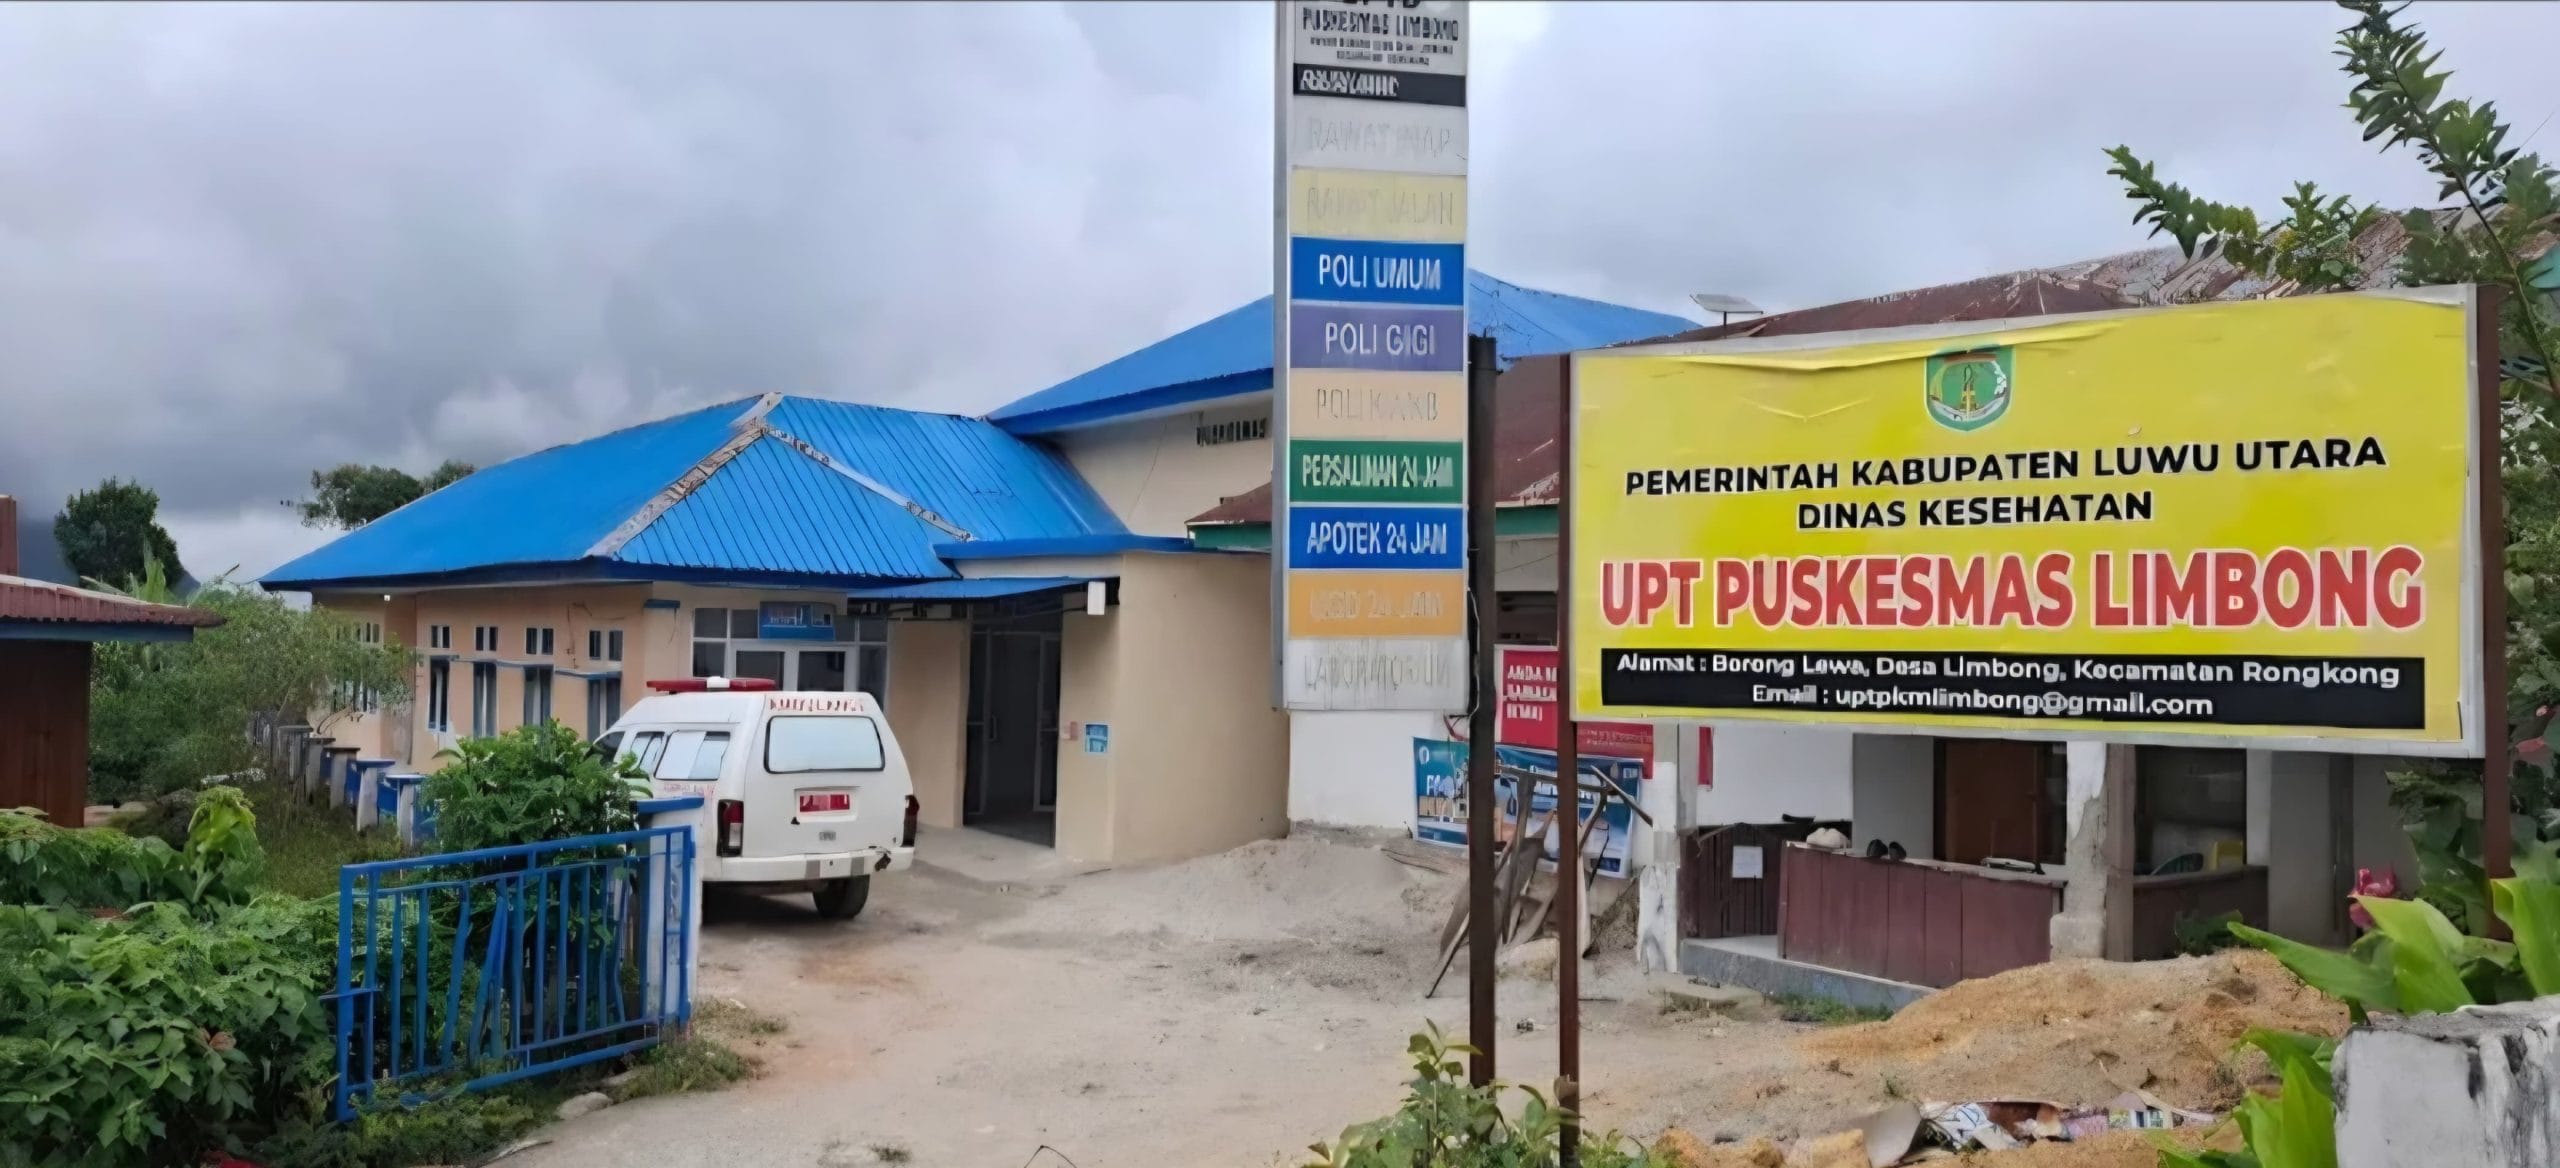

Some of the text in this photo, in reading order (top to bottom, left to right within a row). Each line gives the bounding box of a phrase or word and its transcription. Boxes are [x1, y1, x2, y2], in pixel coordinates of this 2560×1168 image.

[1319, 253, 1441, 291] POLI UMUM
[1325, 322, 1436, 356] POLI GIGI
[1316, 388, 1364, 420] POLI
[1626, 436, 2387, 495] PEMERINTAH KABUPATEN LUWU UTARA
[1798, 491, 2152, 530] DINAS KESEHATAN
[1307, 521, 1447, 554] APOTEK 24 JAM
[1601, 546, 2424, 629] UPT PUSKESMAS LIMBONG
[1617, 653, 1695, 673] Alamat
[1700, 657, 1706, 673] :
[1712, 656, 1795, 677] Borong
[1943, 656, 2067, 682] Limbong,
[2242, 661, 2400, 688] Rongkong
[1752, 684, 1817, 703] Email
[1823, 688, 1829, 703] :
